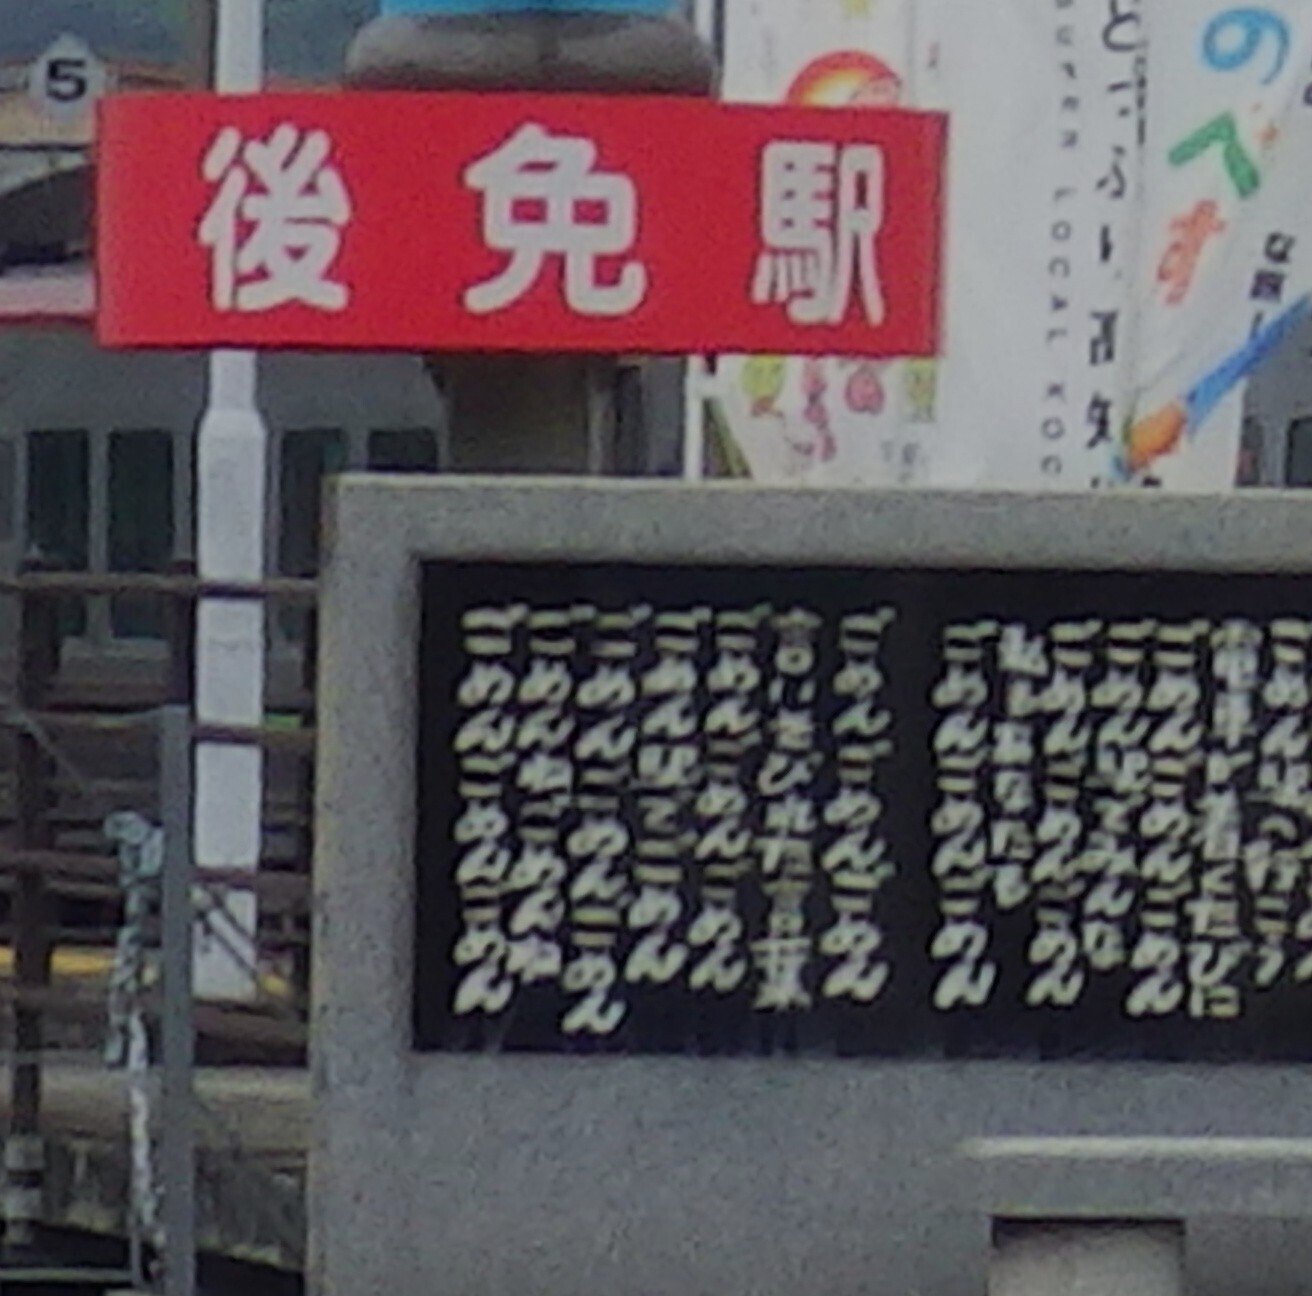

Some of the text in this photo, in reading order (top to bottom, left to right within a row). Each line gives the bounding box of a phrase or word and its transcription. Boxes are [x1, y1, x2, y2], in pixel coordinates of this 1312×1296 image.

[47, 58, 87, 102] 5
[199, 122, 887, 328] 後免駅
[453, 603, 529, 1016] ごめんごめんごめん
[561, 602, 652, 1036] ごめんごめんごめん
[688, 602, 773, 992] ごめんごめんごめん
[821, 605, 898, 1001] ごめんごめんごめん
[930, 619, 999, 1011] ごめんごめんごめん
[1026, 619, 1102, 1007] ごめんごめんごめん
[1125, 619, 1211, 1017] ごめんごめんごめん
